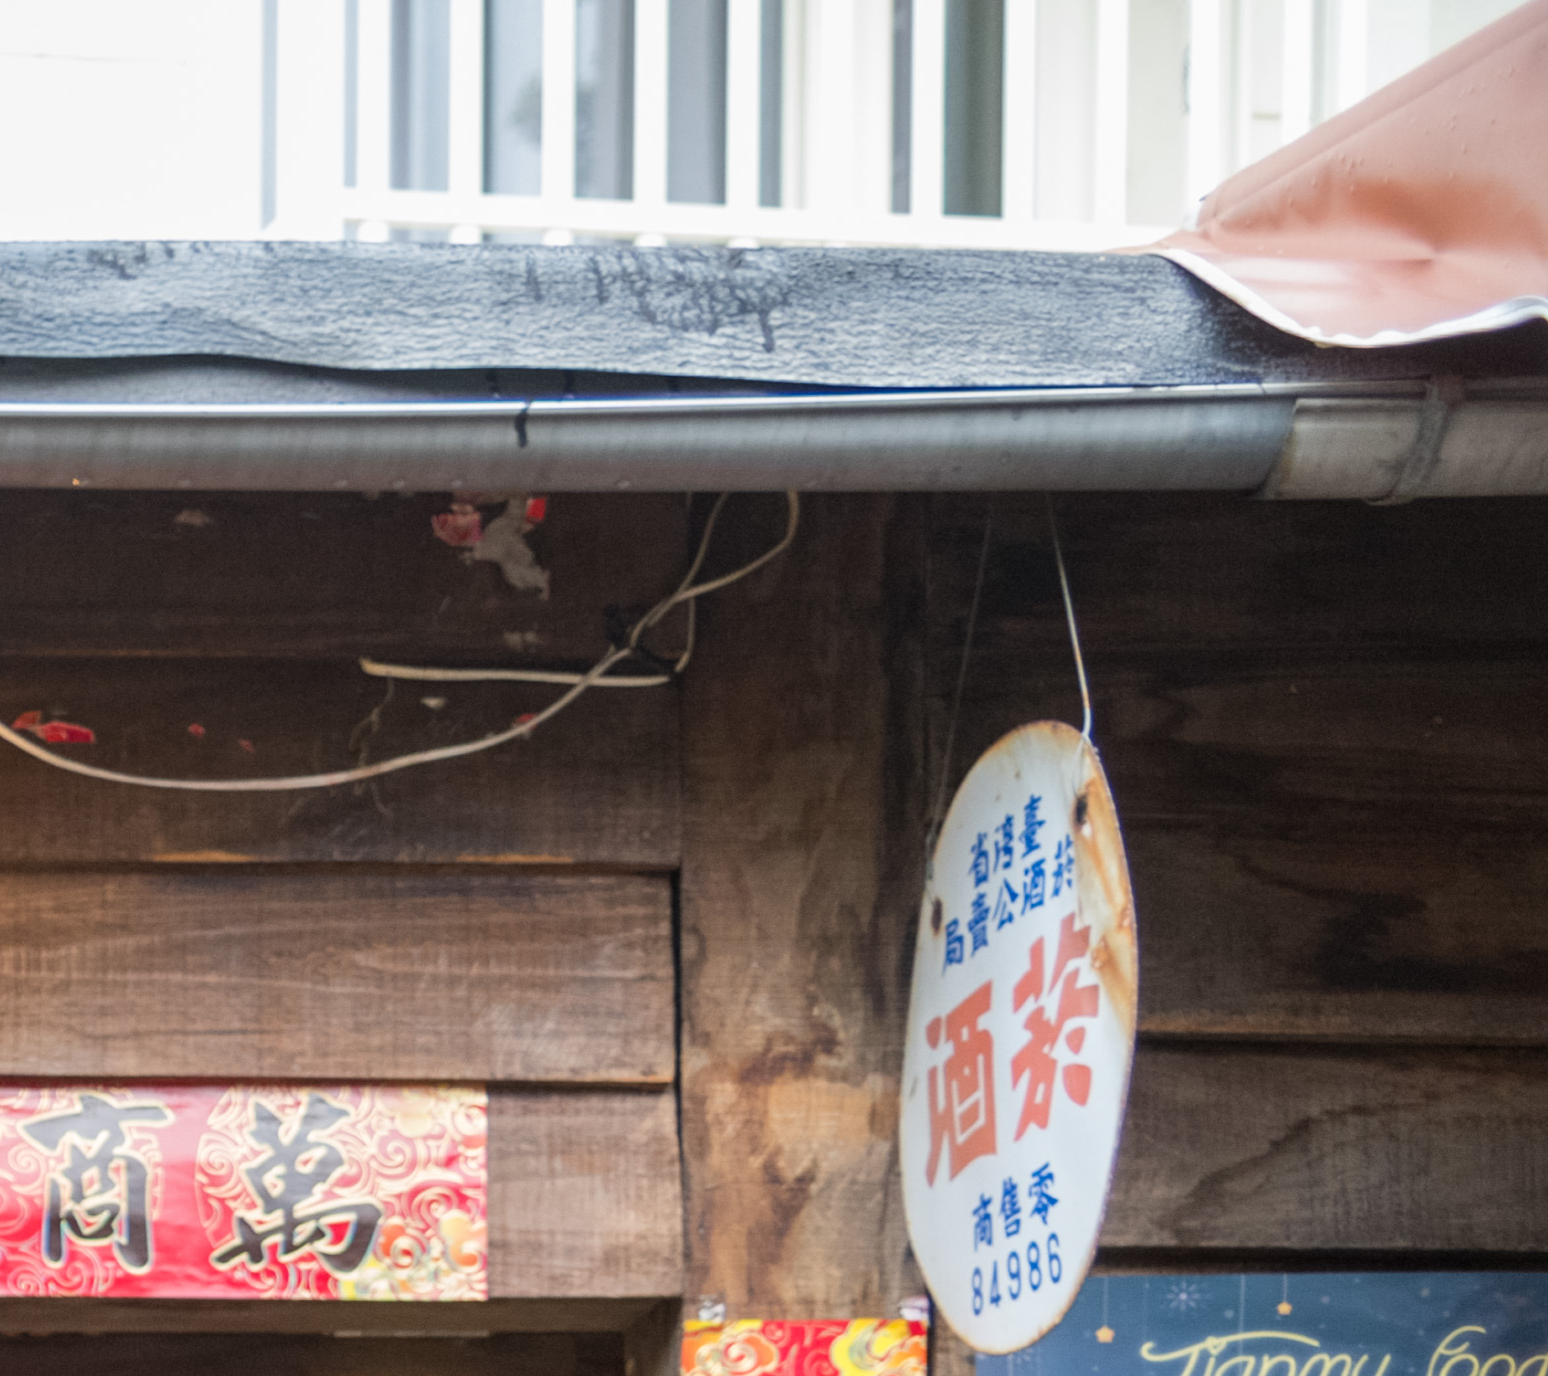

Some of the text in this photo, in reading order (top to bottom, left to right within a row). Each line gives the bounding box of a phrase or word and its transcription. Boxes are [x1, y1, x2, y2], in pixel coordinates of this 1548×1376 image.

[925, 911, 1100, 1188] 菸酒
[973, 1161, 1060, 1253] 零售商
[971, 1233, 1064, 1316] 84986
